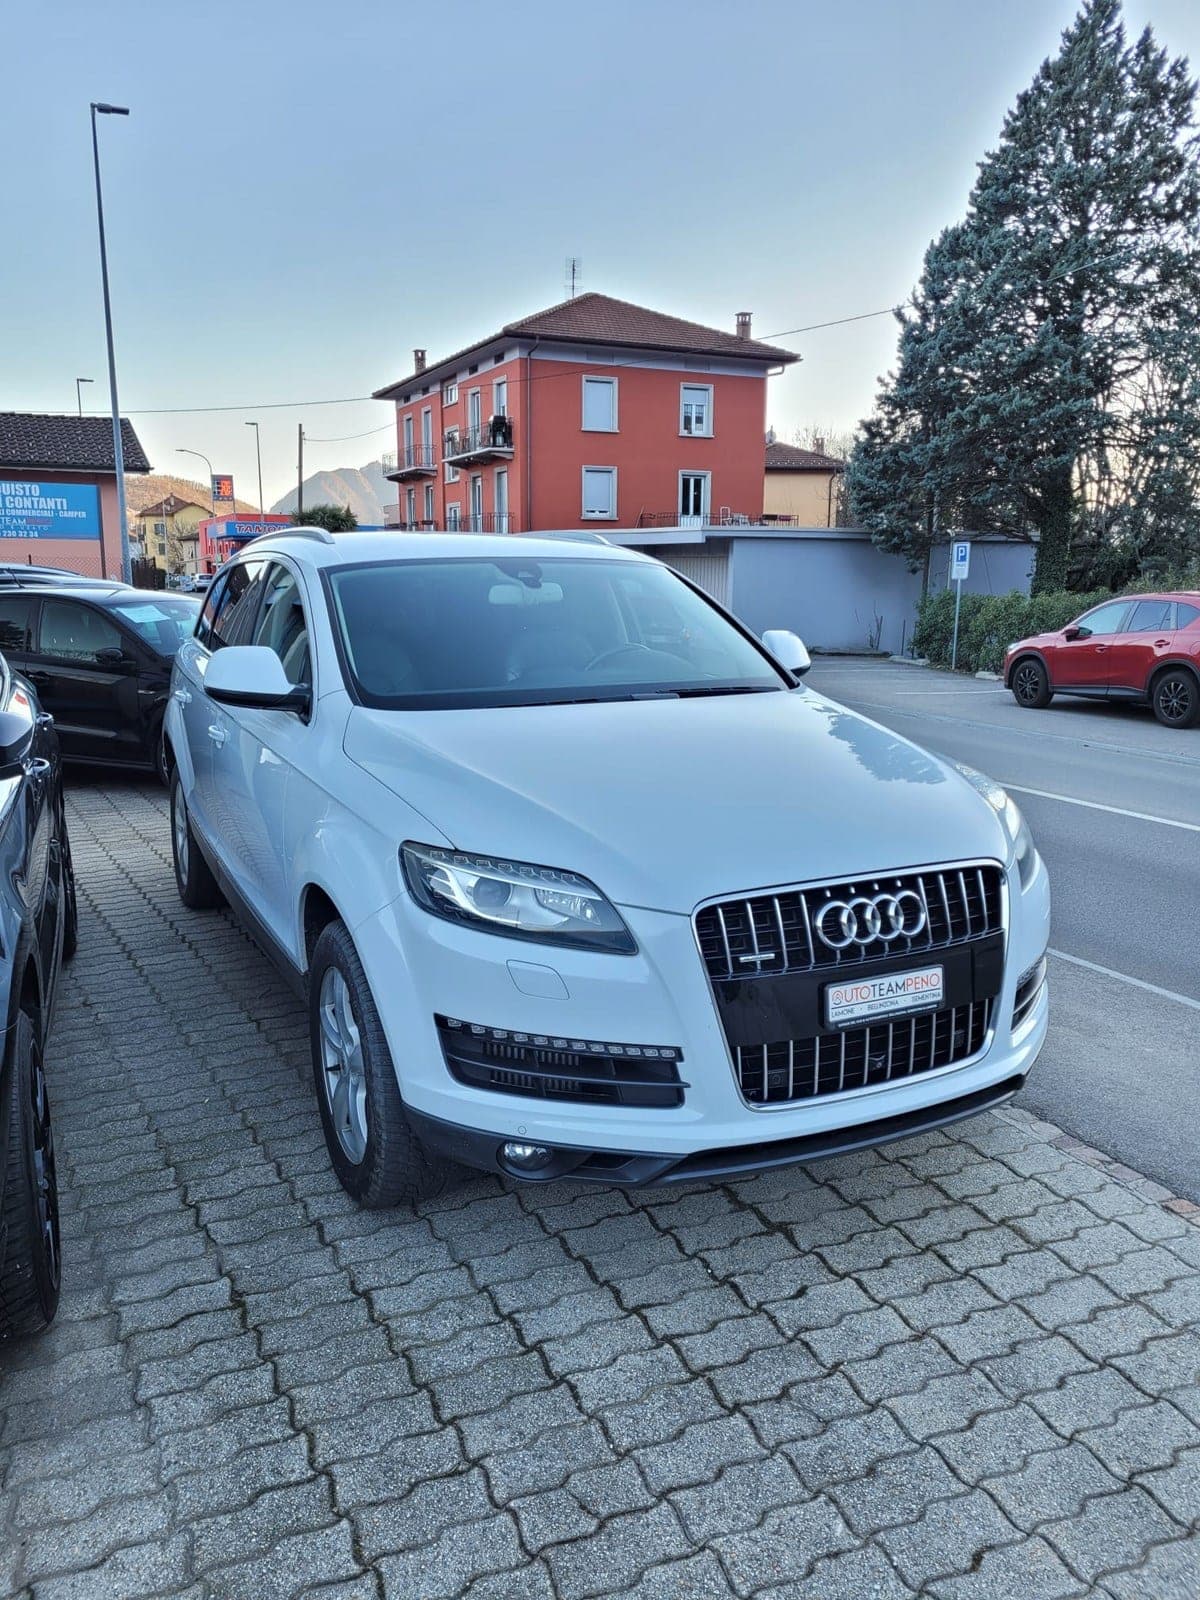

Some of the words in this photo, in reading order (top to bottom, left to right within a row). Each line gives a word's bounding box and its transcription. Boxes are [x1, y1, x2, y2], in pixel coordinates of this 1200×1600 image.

[0, 483, 40, 496] UISTO
[5, 496, 67, 510] CONTANTI
[958, 547, 966, 561] P
[831, 1007, 856, 1018] LAMONE
[867, 1000, 899, 1012] BELLINZONA
